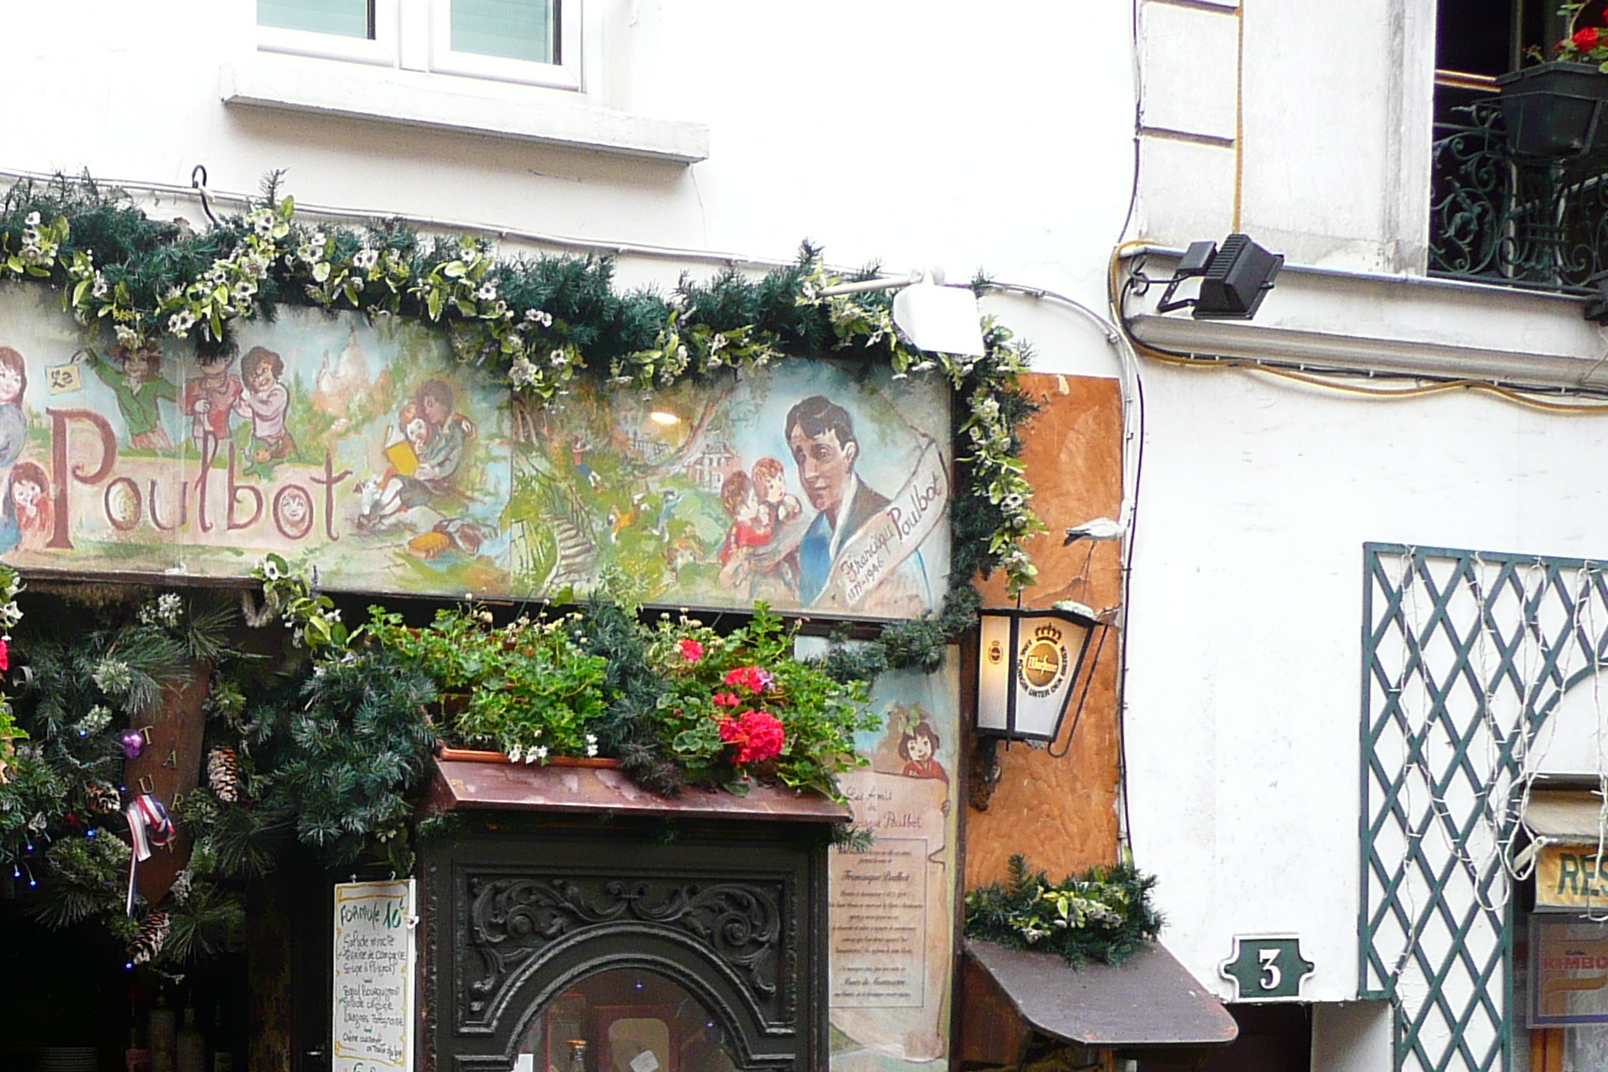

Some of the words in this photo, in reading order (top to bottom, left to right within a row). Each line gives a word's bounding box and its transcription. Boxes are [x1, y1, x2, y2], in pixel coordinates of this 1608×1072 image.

[45, 406, 354, 550] Poulbot
[886, 471, 942, 541] Poulbot
[1258, 948, 1281, 990] 3
